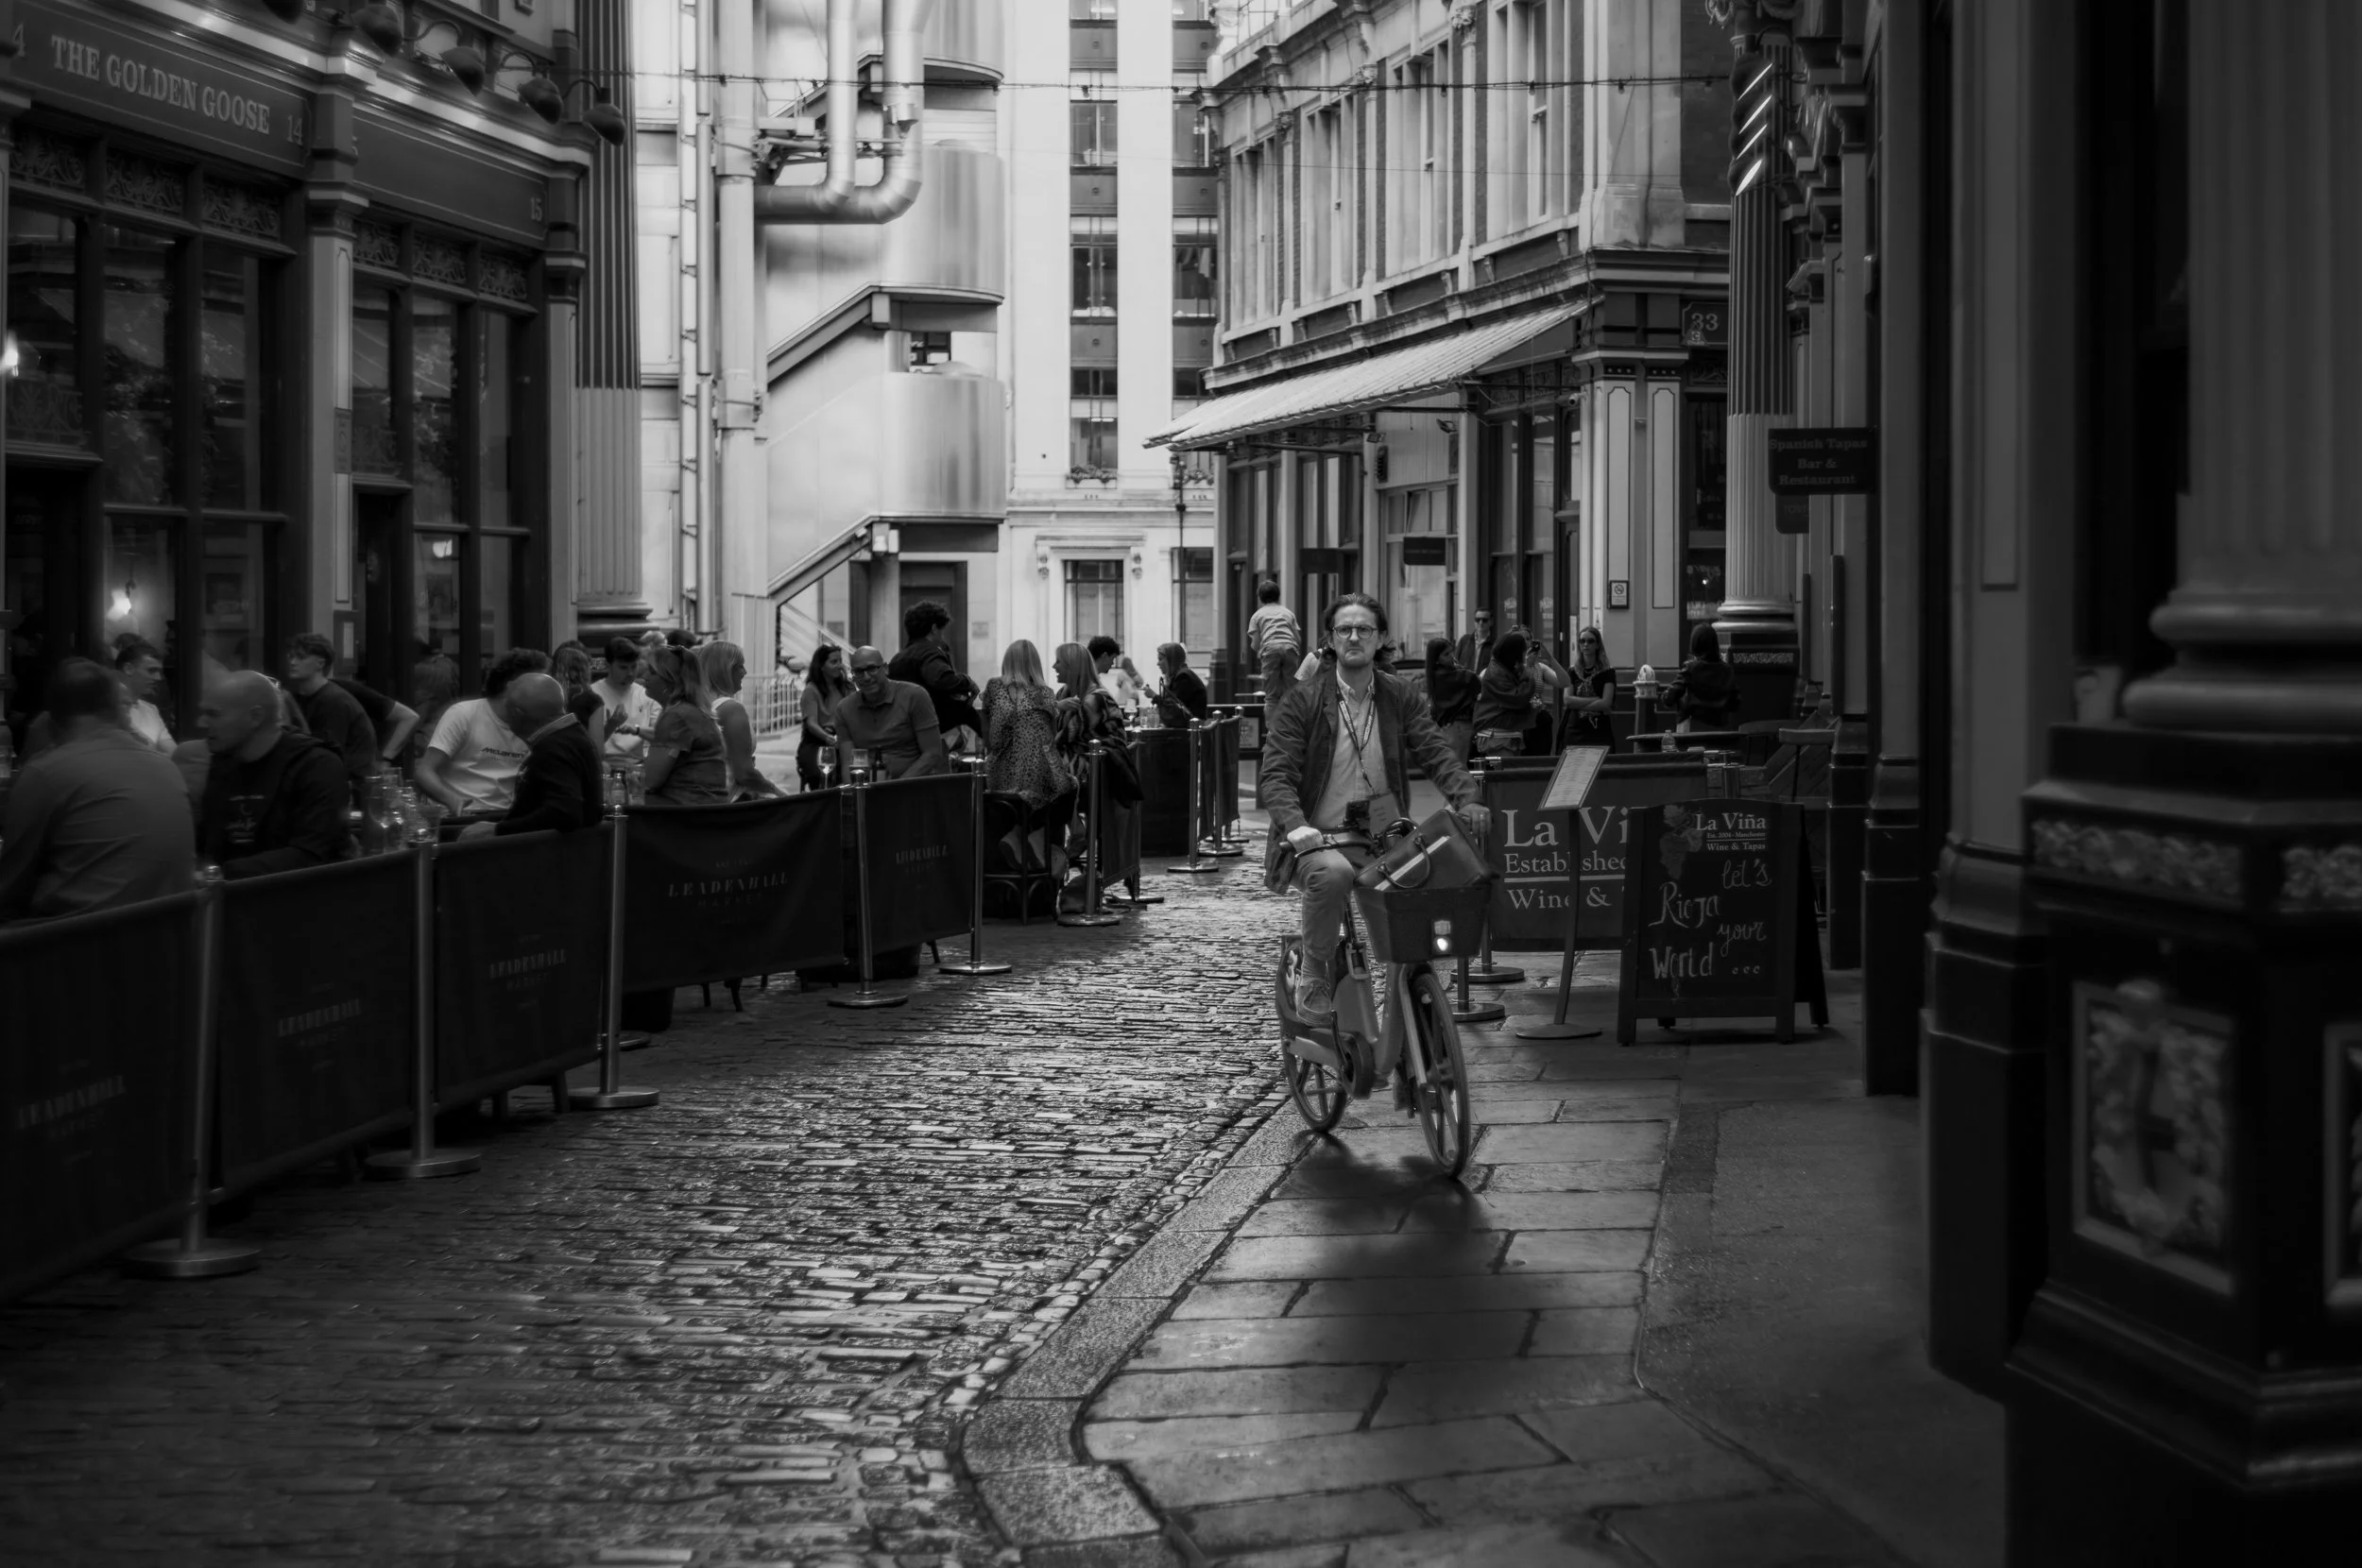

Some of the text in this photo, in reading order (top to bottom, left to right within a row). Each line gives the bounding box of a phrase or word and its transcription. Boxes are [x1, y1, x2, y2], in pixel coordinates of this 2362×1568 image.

[51, 34, 270, 135] THE GOLDEN GOOSE
[287, 114, 303, 147] 14
[530, 196, 543, 224] 15
[1691, 312, 1720, 332] 33
[1769, 437, 1868, 453] Spanish Tapas
[1797, 457, 1839, 469] Bar &
[1777, 474, 1857, 486] Restaurant
[1500, 805, 1630, 847] La Vi
[1695, 811, 1767, 831] La Viña
[1706, 842, 1766, 852] Wine & Tapas
[668, 871, 789, 898] LEADENHALL
[1586, 886, 1613, 908] &
[697, 892, 762, 909] MARKET
[1717, 921, 1768, 958] your
[488, 947, 568, 980] LEADENHALL
[1649, 941, 1715, 980] World
[277, 997, 363, 1038] LEADENHALL
